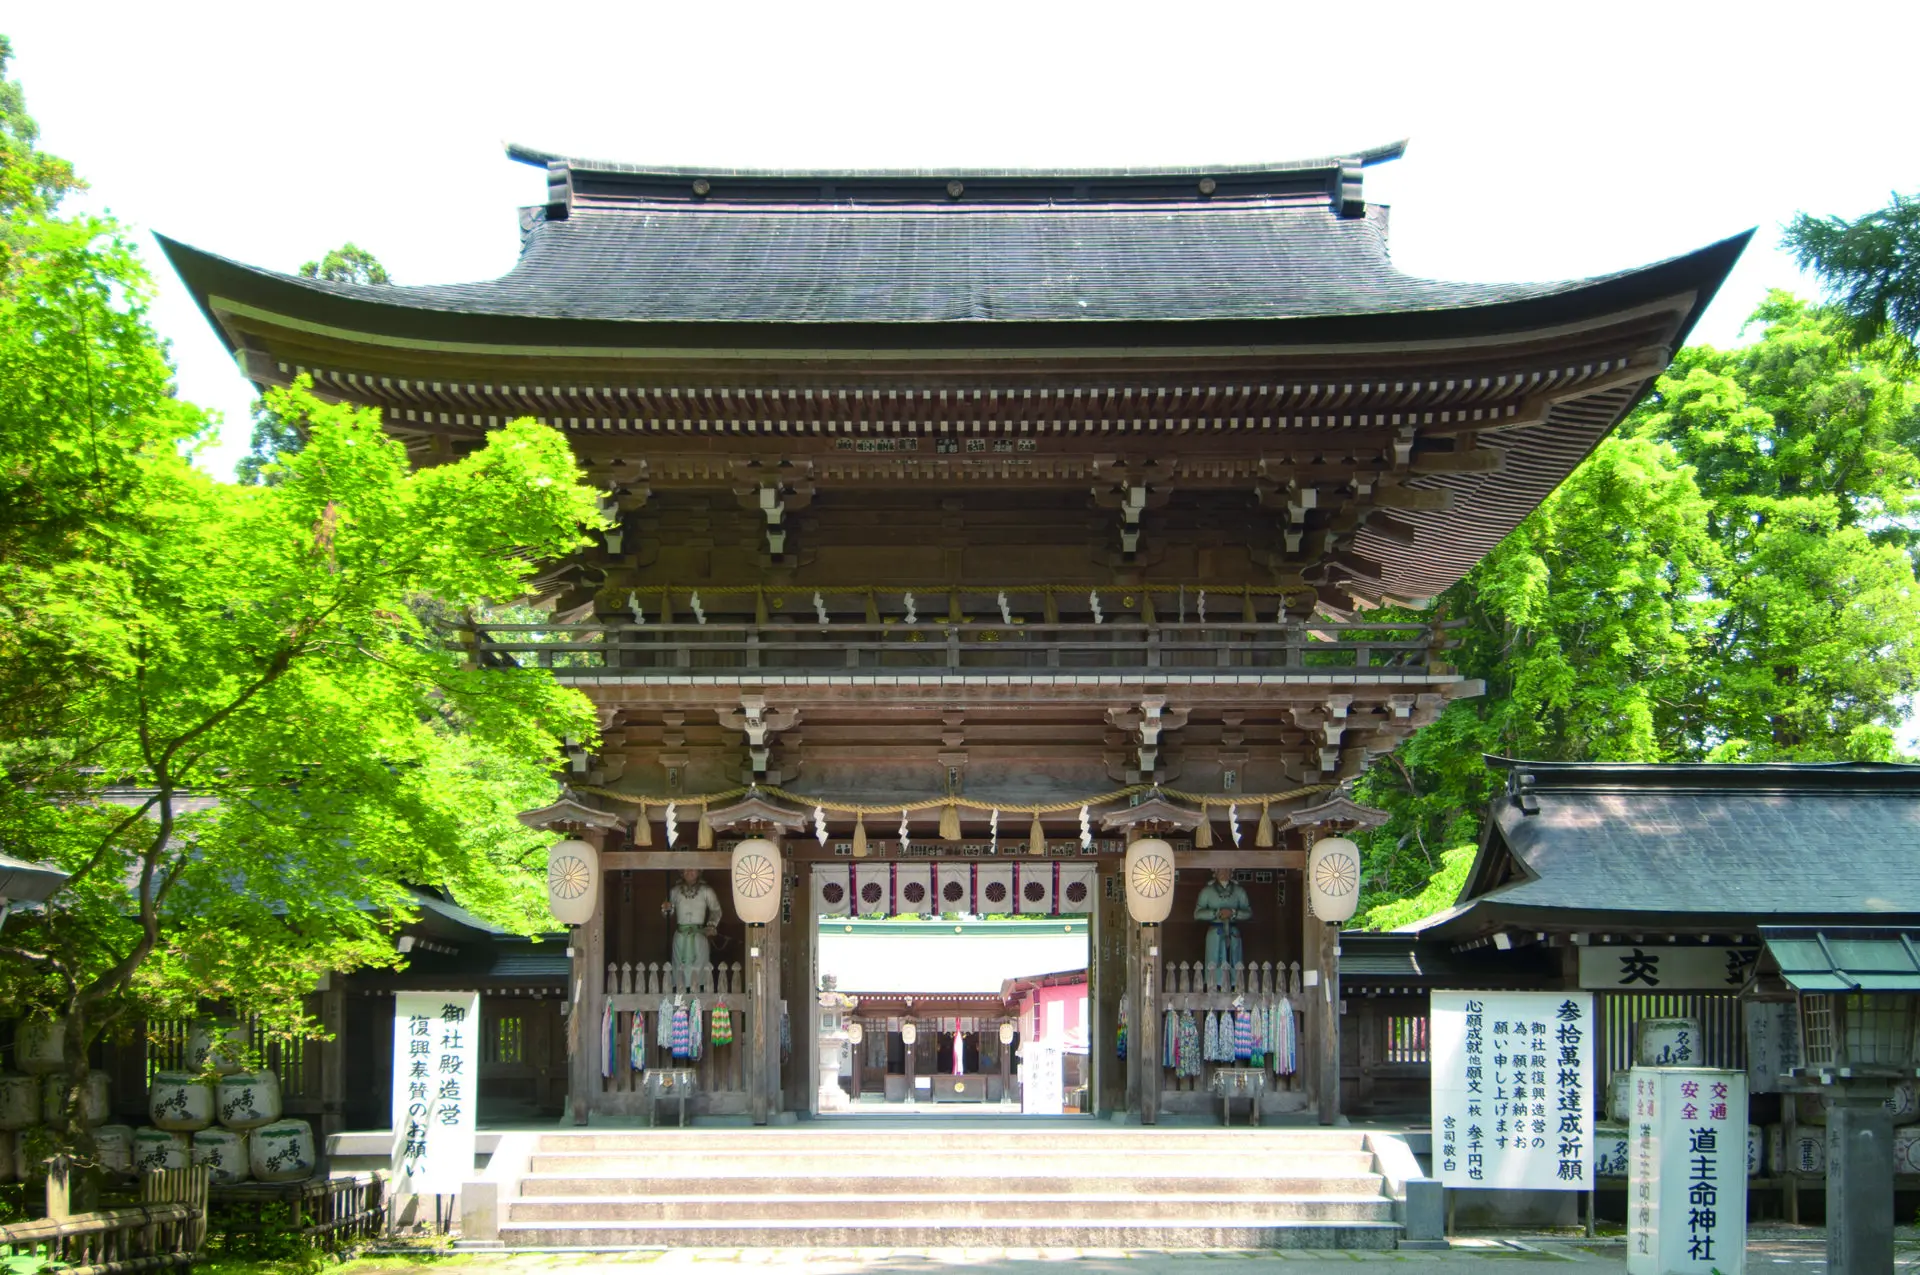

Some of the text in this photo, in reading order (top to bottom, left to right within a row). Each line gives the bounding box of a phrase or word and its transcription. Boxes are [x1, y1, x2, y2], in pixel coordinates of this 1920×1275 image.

[403, 1015, 431, 1178] 復興奉賛のお願い
[438, 1003, 465, 1126] 御社殿造営
[1465, 999, 1483, 1117] 心願成就他願文一枚
[1493, 1021, 1509, 1150] 願い申し上げます
[1512, 1021, 1528, 1149] 為、願文奉納をお
[1530, 1021, 1546, 1149] 御社殿復興造営の
[1680, 1081, 1699, 1120] 安全
[1709, 1081, 1728, 1121] 交通
[1443, 1115, 1456, 1172] 宮司敬白
[1687, 1127, 1718, 1261] 道主命神社
